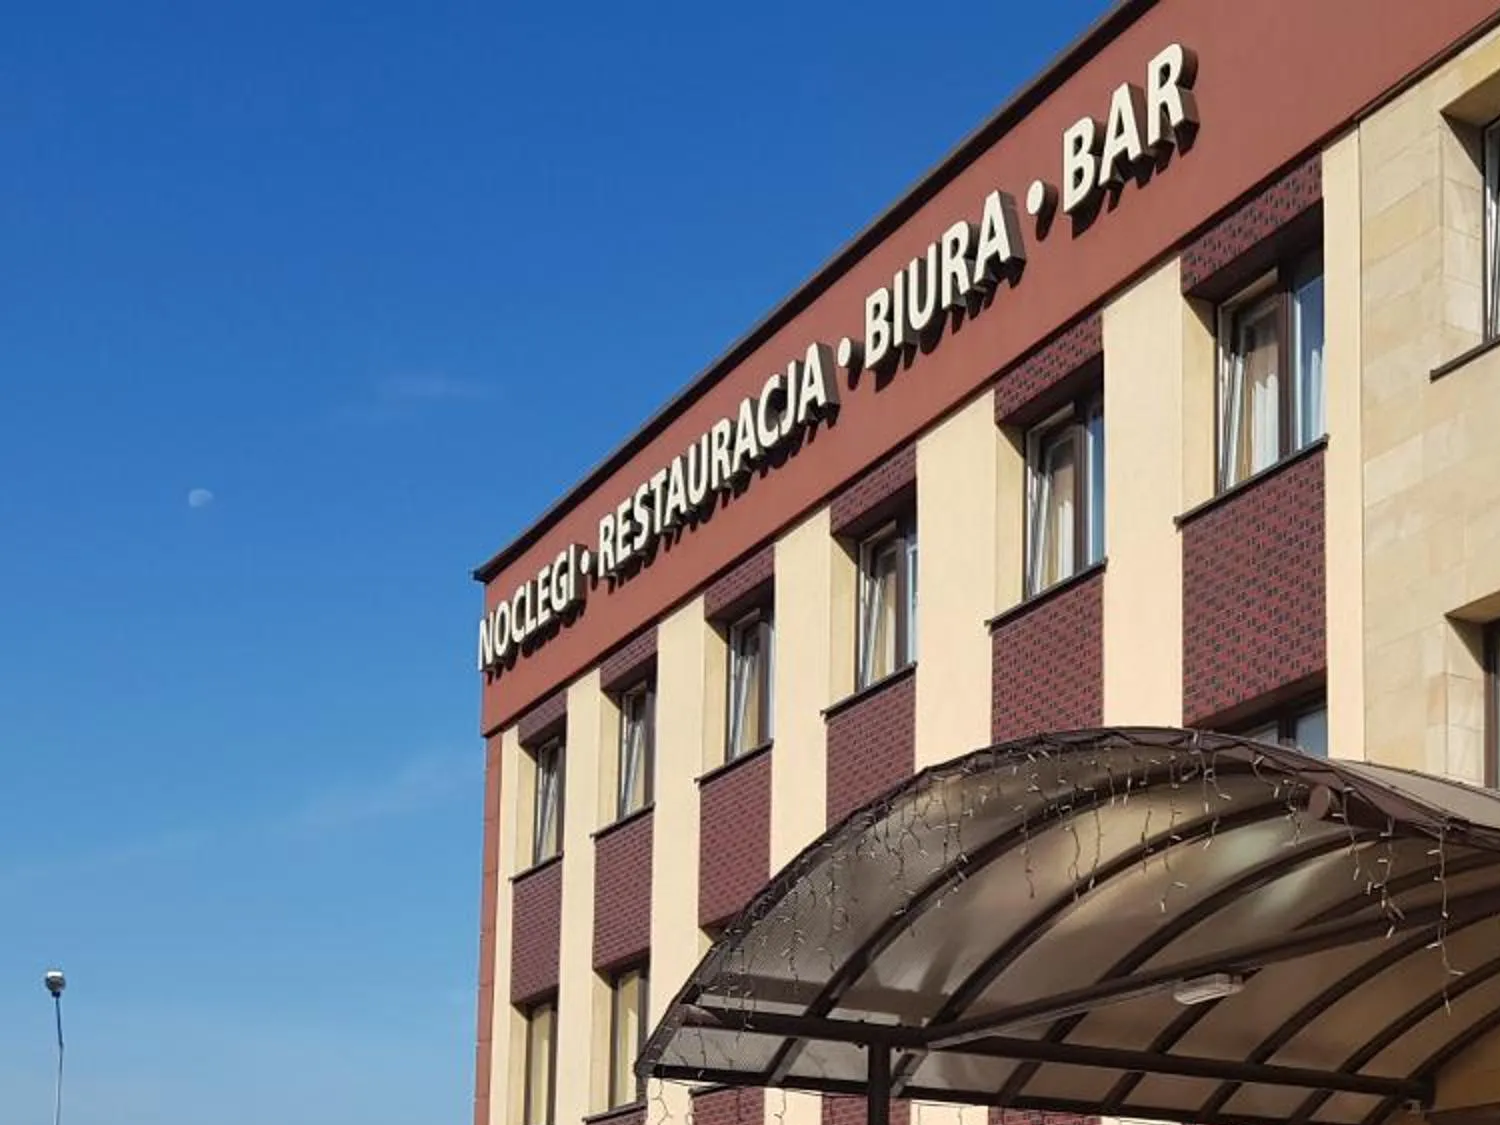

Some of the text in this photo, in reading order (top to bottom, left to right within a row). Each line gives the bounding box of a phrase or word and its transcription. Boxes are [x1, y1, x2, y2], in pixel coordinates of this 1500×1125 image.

[478, 42, 1186, 672] NOCLEGI RESTAURACJA BIURA BAR
